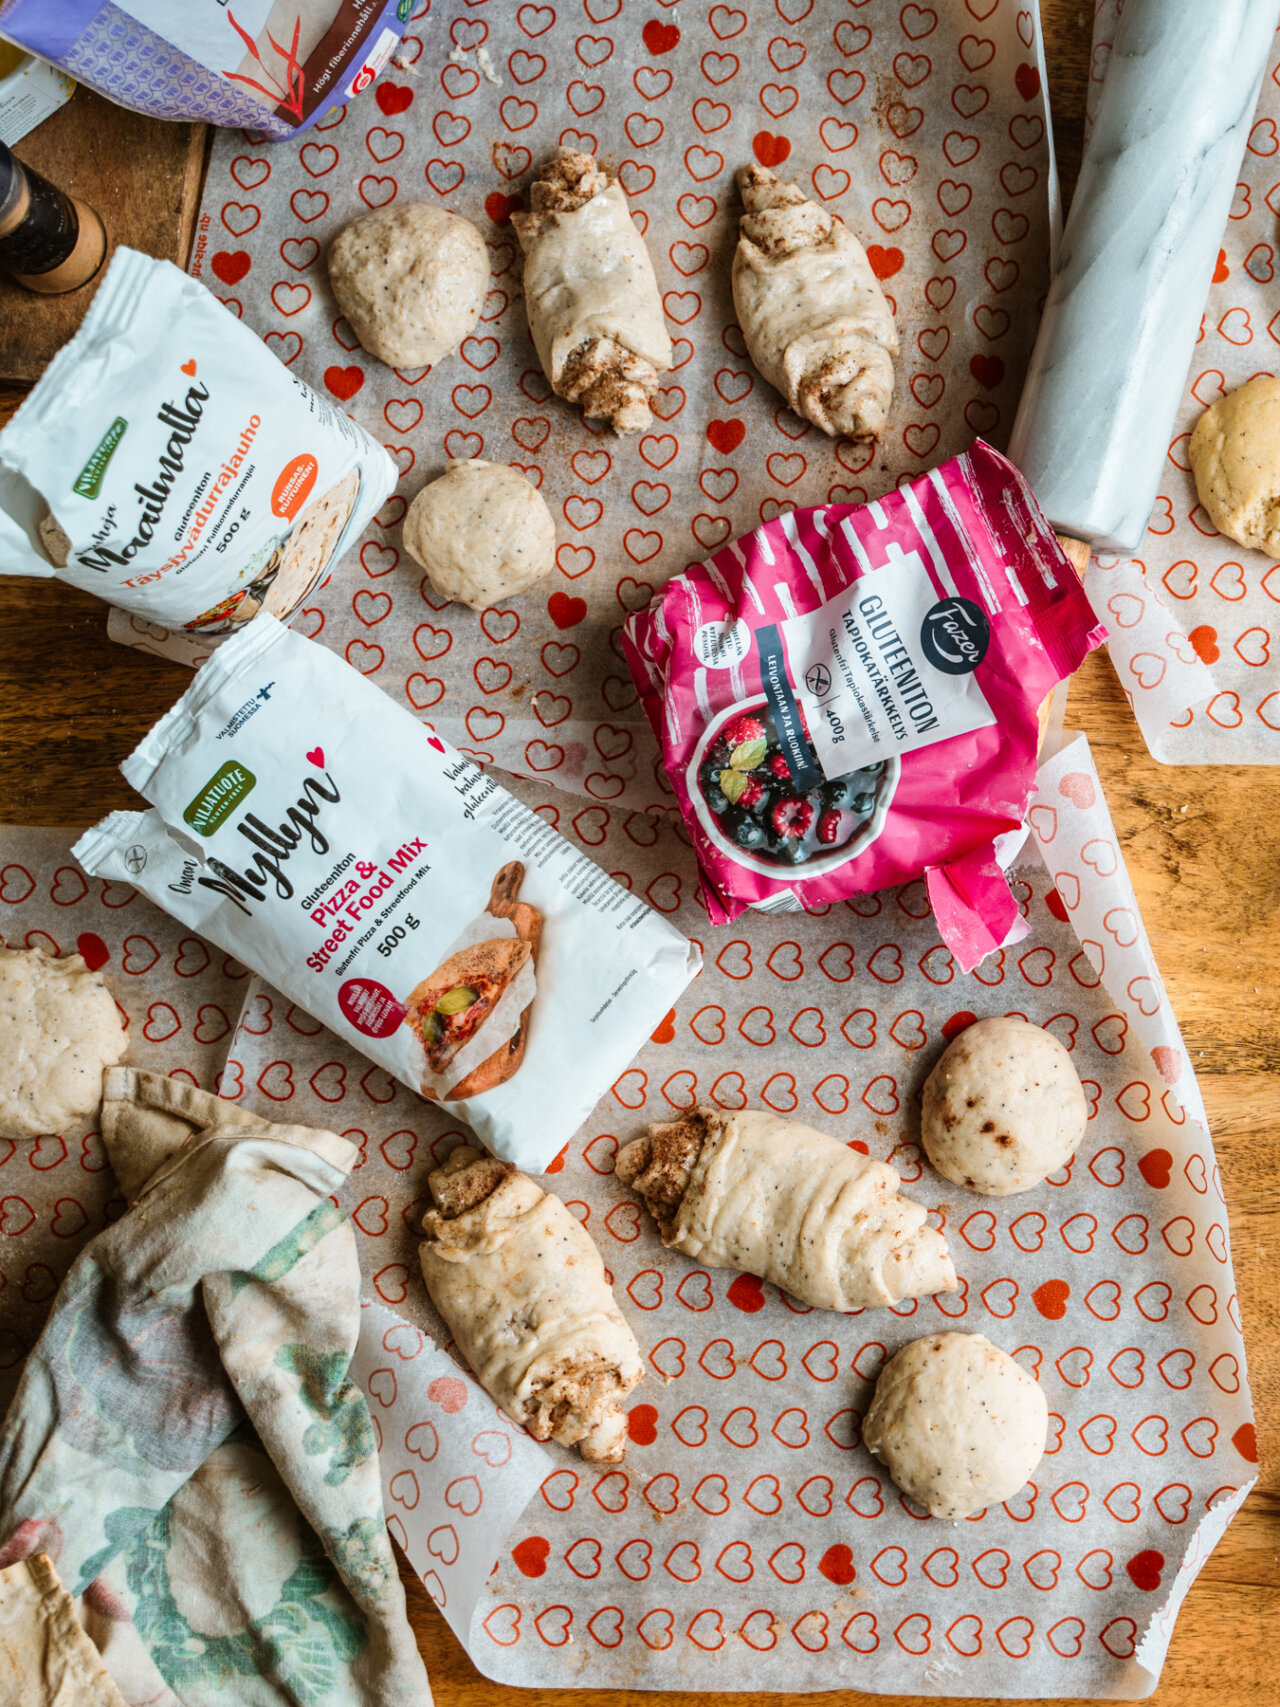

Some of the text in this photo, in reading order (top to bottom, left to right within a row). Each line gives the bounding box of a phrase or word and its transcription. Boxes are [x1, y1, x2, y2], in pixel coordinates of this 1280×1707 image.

[312, 68, 333, 92] Högt
[328, 5, 372, 68] fiberinnehåll
[77, 382, 211, 574] Maailmalta
[119, 412, 263, 590] Täysjyvädurrajauho
[174, 471, 212, 540] Gluteeniton
[276, 461, 307, 502] RUNSAS-
[279, 461, 315, 512] KUITUINEN!
[175, 463, 255, 574] Glutenfri Fullkornsdurramjöl
[215, 506, 251, 553] 500 g
[857, 593, 940, 733] GLUTEENITON
[928, 602, 982, 663] Fazer
[827, 628, 880, 743] Glutenfri Tapiokastärkelse
[840, 609, 909, 741] TAPIOKATÄRKKELYS
[215, 697, 256, 741] VALMISTETTU
[227, 702, 262, 738] SUOMESSA
[765, 654, 807, 770] LEIVONTAAN JA RUOKIIN!
[824, 707, 847, 742] 400g
[192, 768, 246, 827] VILJATUOTE
[208, 784, 244, 823] GLUTEN-FREE
[168, 857, 199, 896] Oman
[197, 772, 340, 917] Myllyn
[299, 850, 356, 911] Gluteeniton
[305, 833, 428, 974] Street Food Mix
[309, 856, 378, 928] Pizza &
[334, 863, 431, 977] Glutenfri Pizza & Streetfood Mix
[375, 913, 421, 958] 500 g
